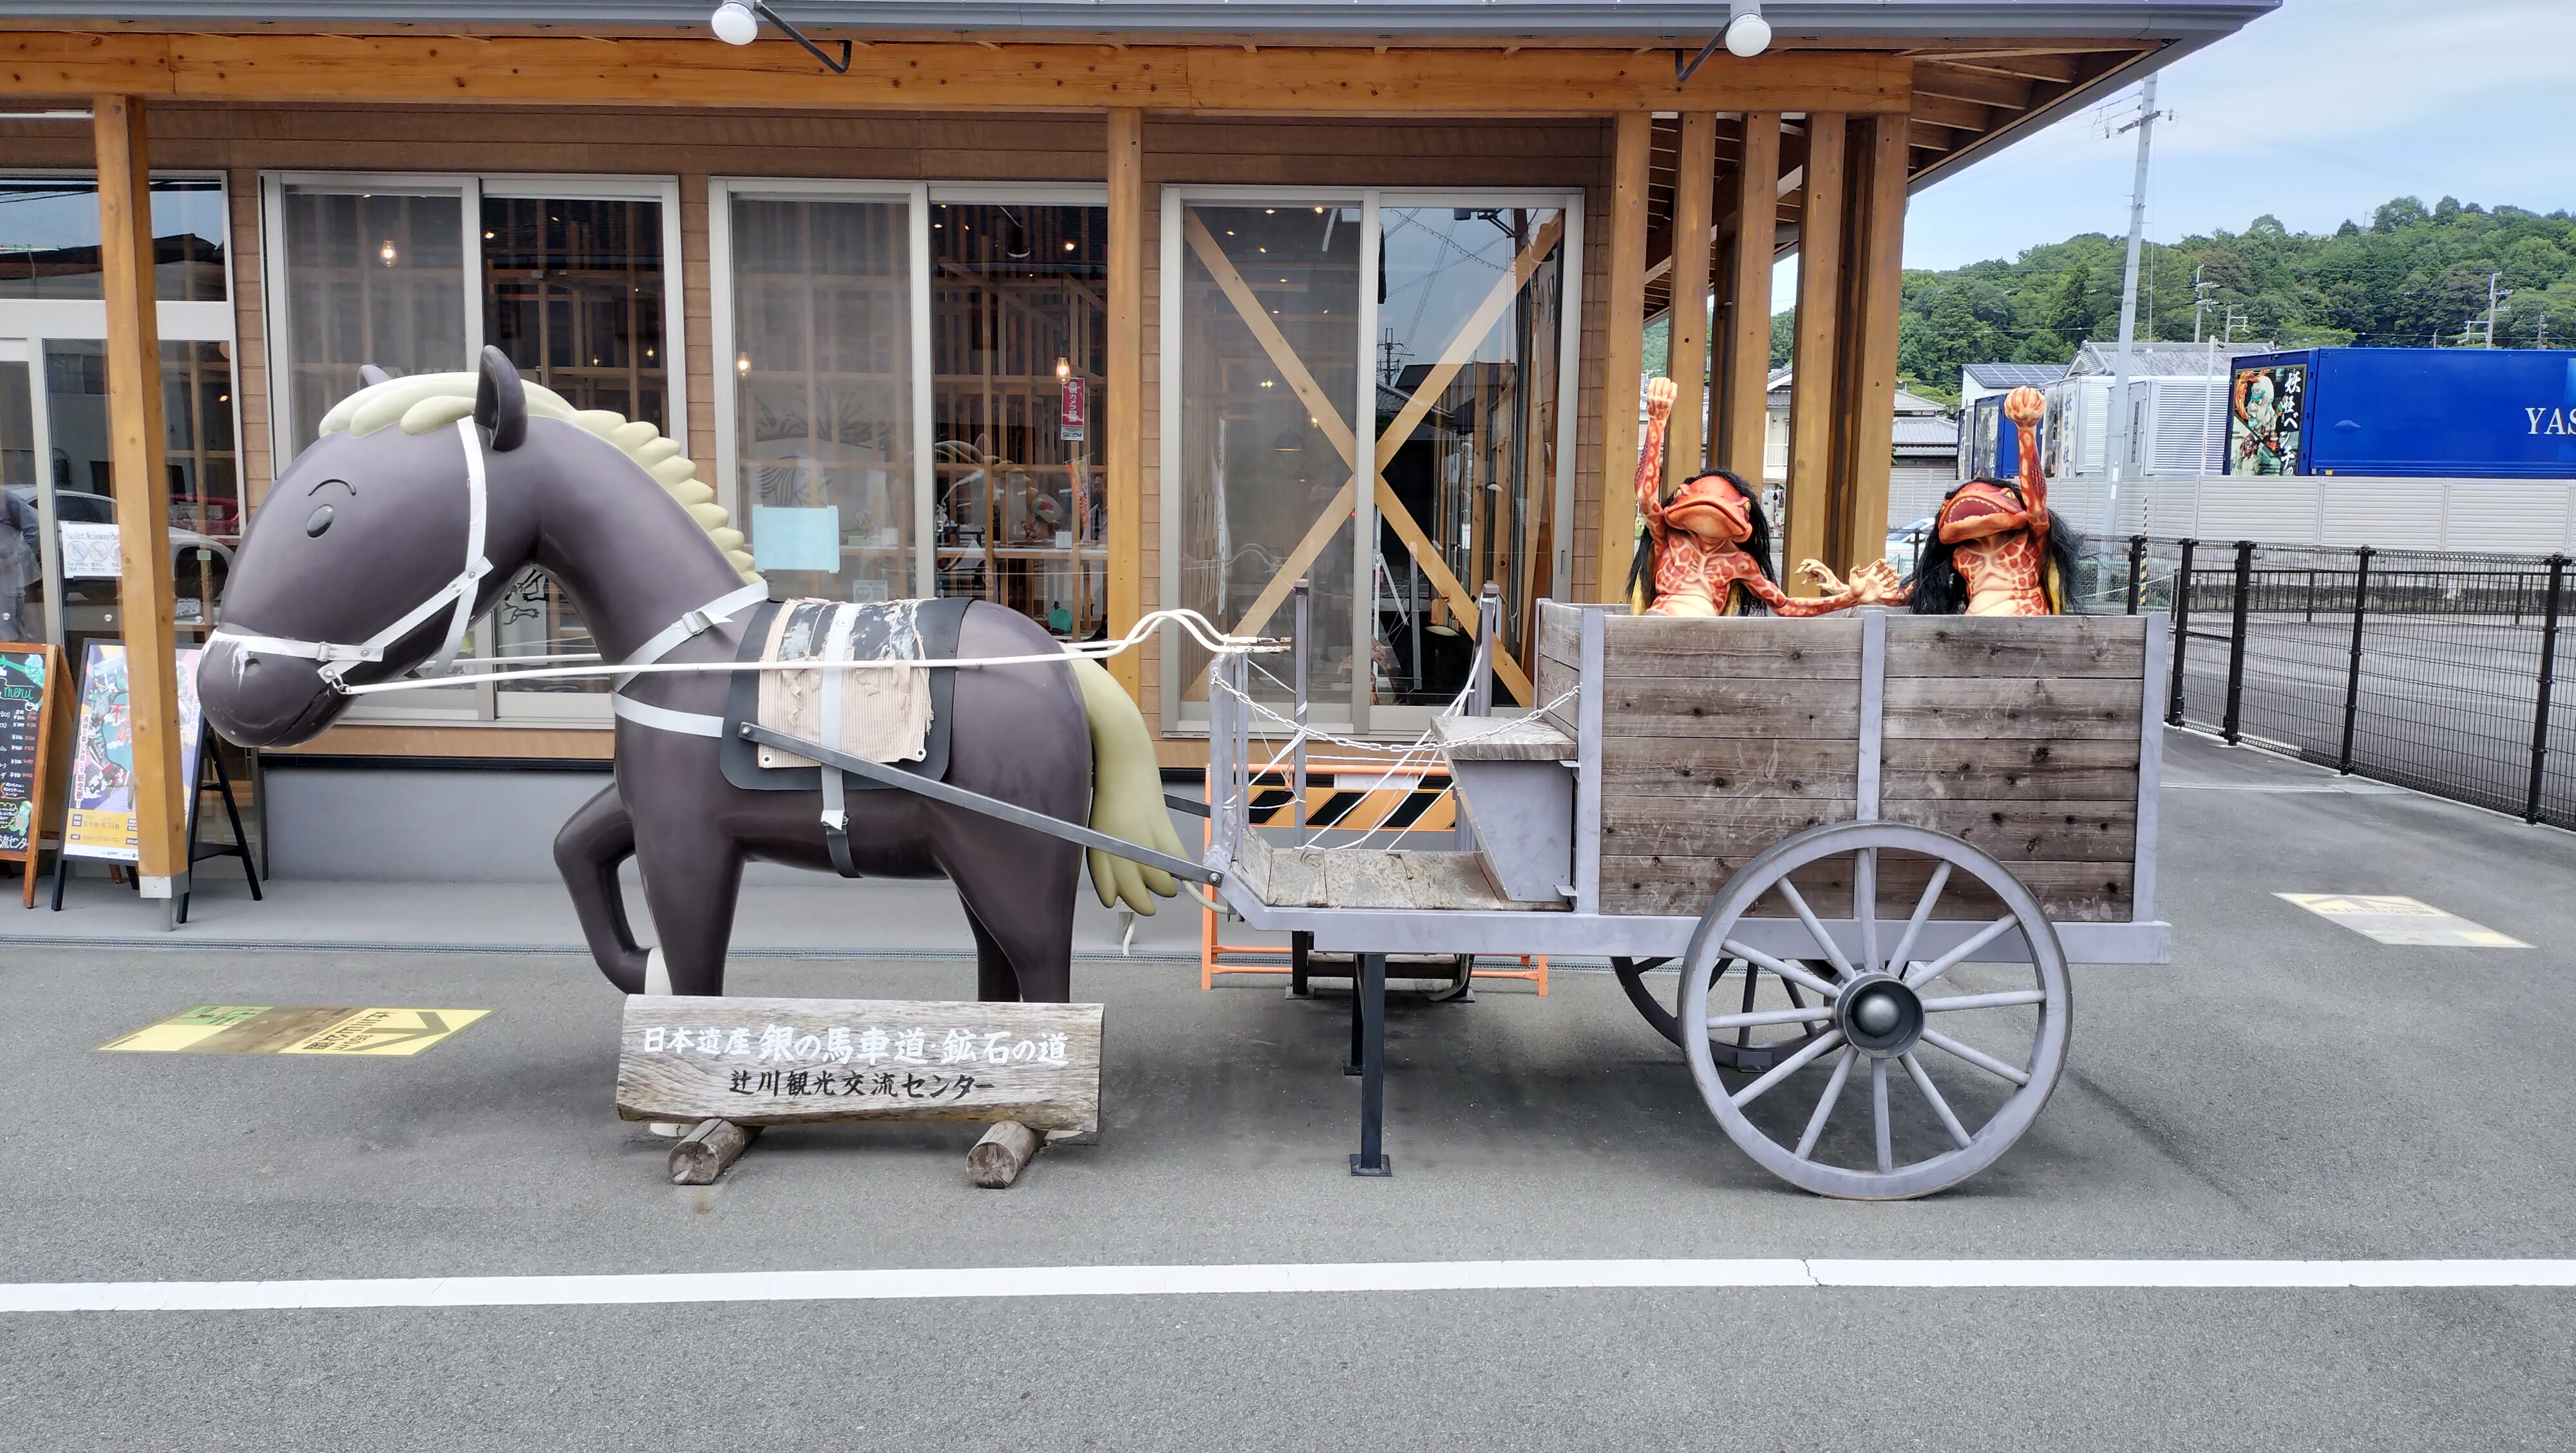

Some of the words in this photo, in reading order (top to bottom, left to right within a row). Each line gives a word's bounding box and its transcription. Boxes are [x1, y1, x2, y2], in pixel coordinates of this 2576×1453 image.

[729, 1069, 996, 1099] 辻川観光交流センター
